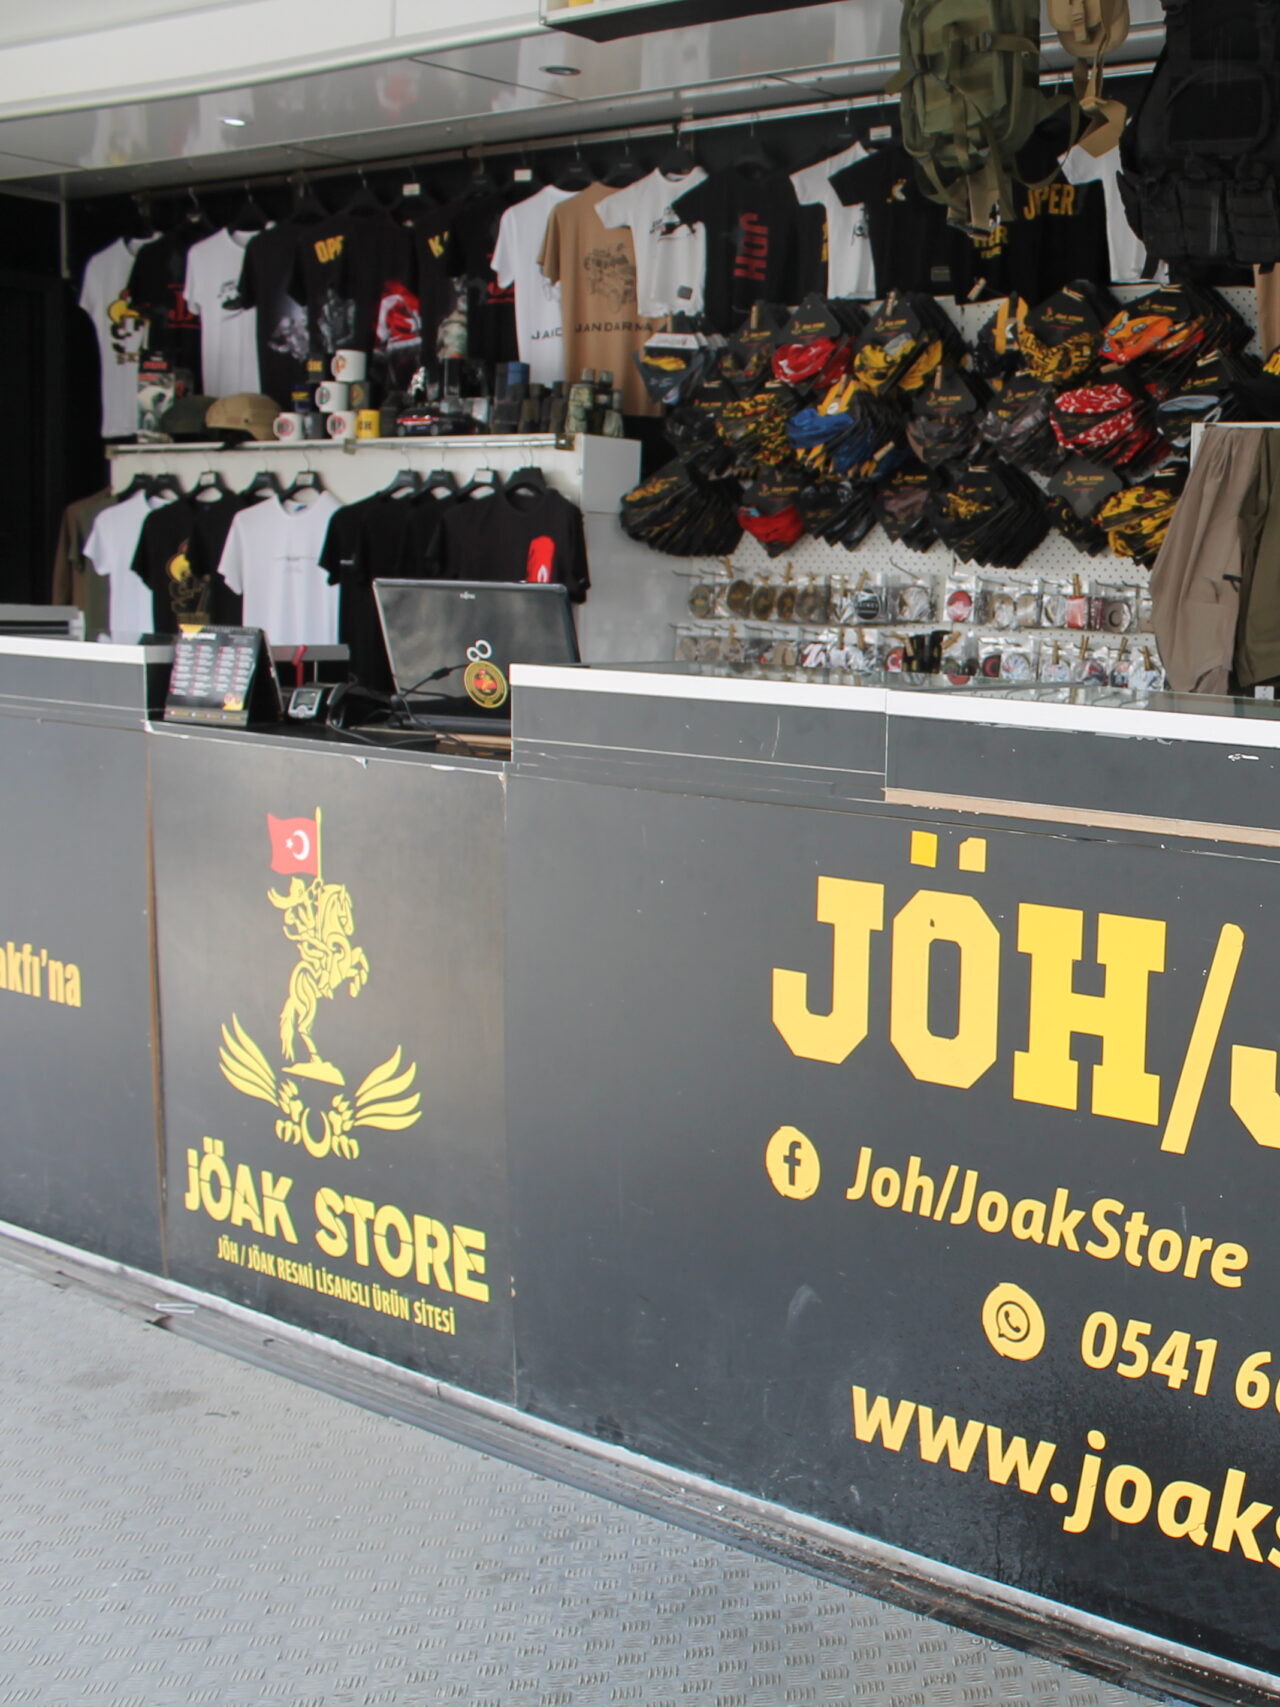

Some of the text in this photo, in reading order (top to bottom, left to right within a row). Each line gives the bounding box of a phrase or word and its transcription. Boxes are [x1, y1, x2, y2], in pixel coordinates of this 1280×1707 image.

[184, 1136, 490, 1303] JÖAK STORE
[846, 1146, 1249, 1288] Joh/JoakStore
[217, 1234, 456, 1335] JÖH / JÖAK RESMİ LİSANSLI ÜRÜN SİTESİ
[1081, 1311, 1218, 1396] 0541
